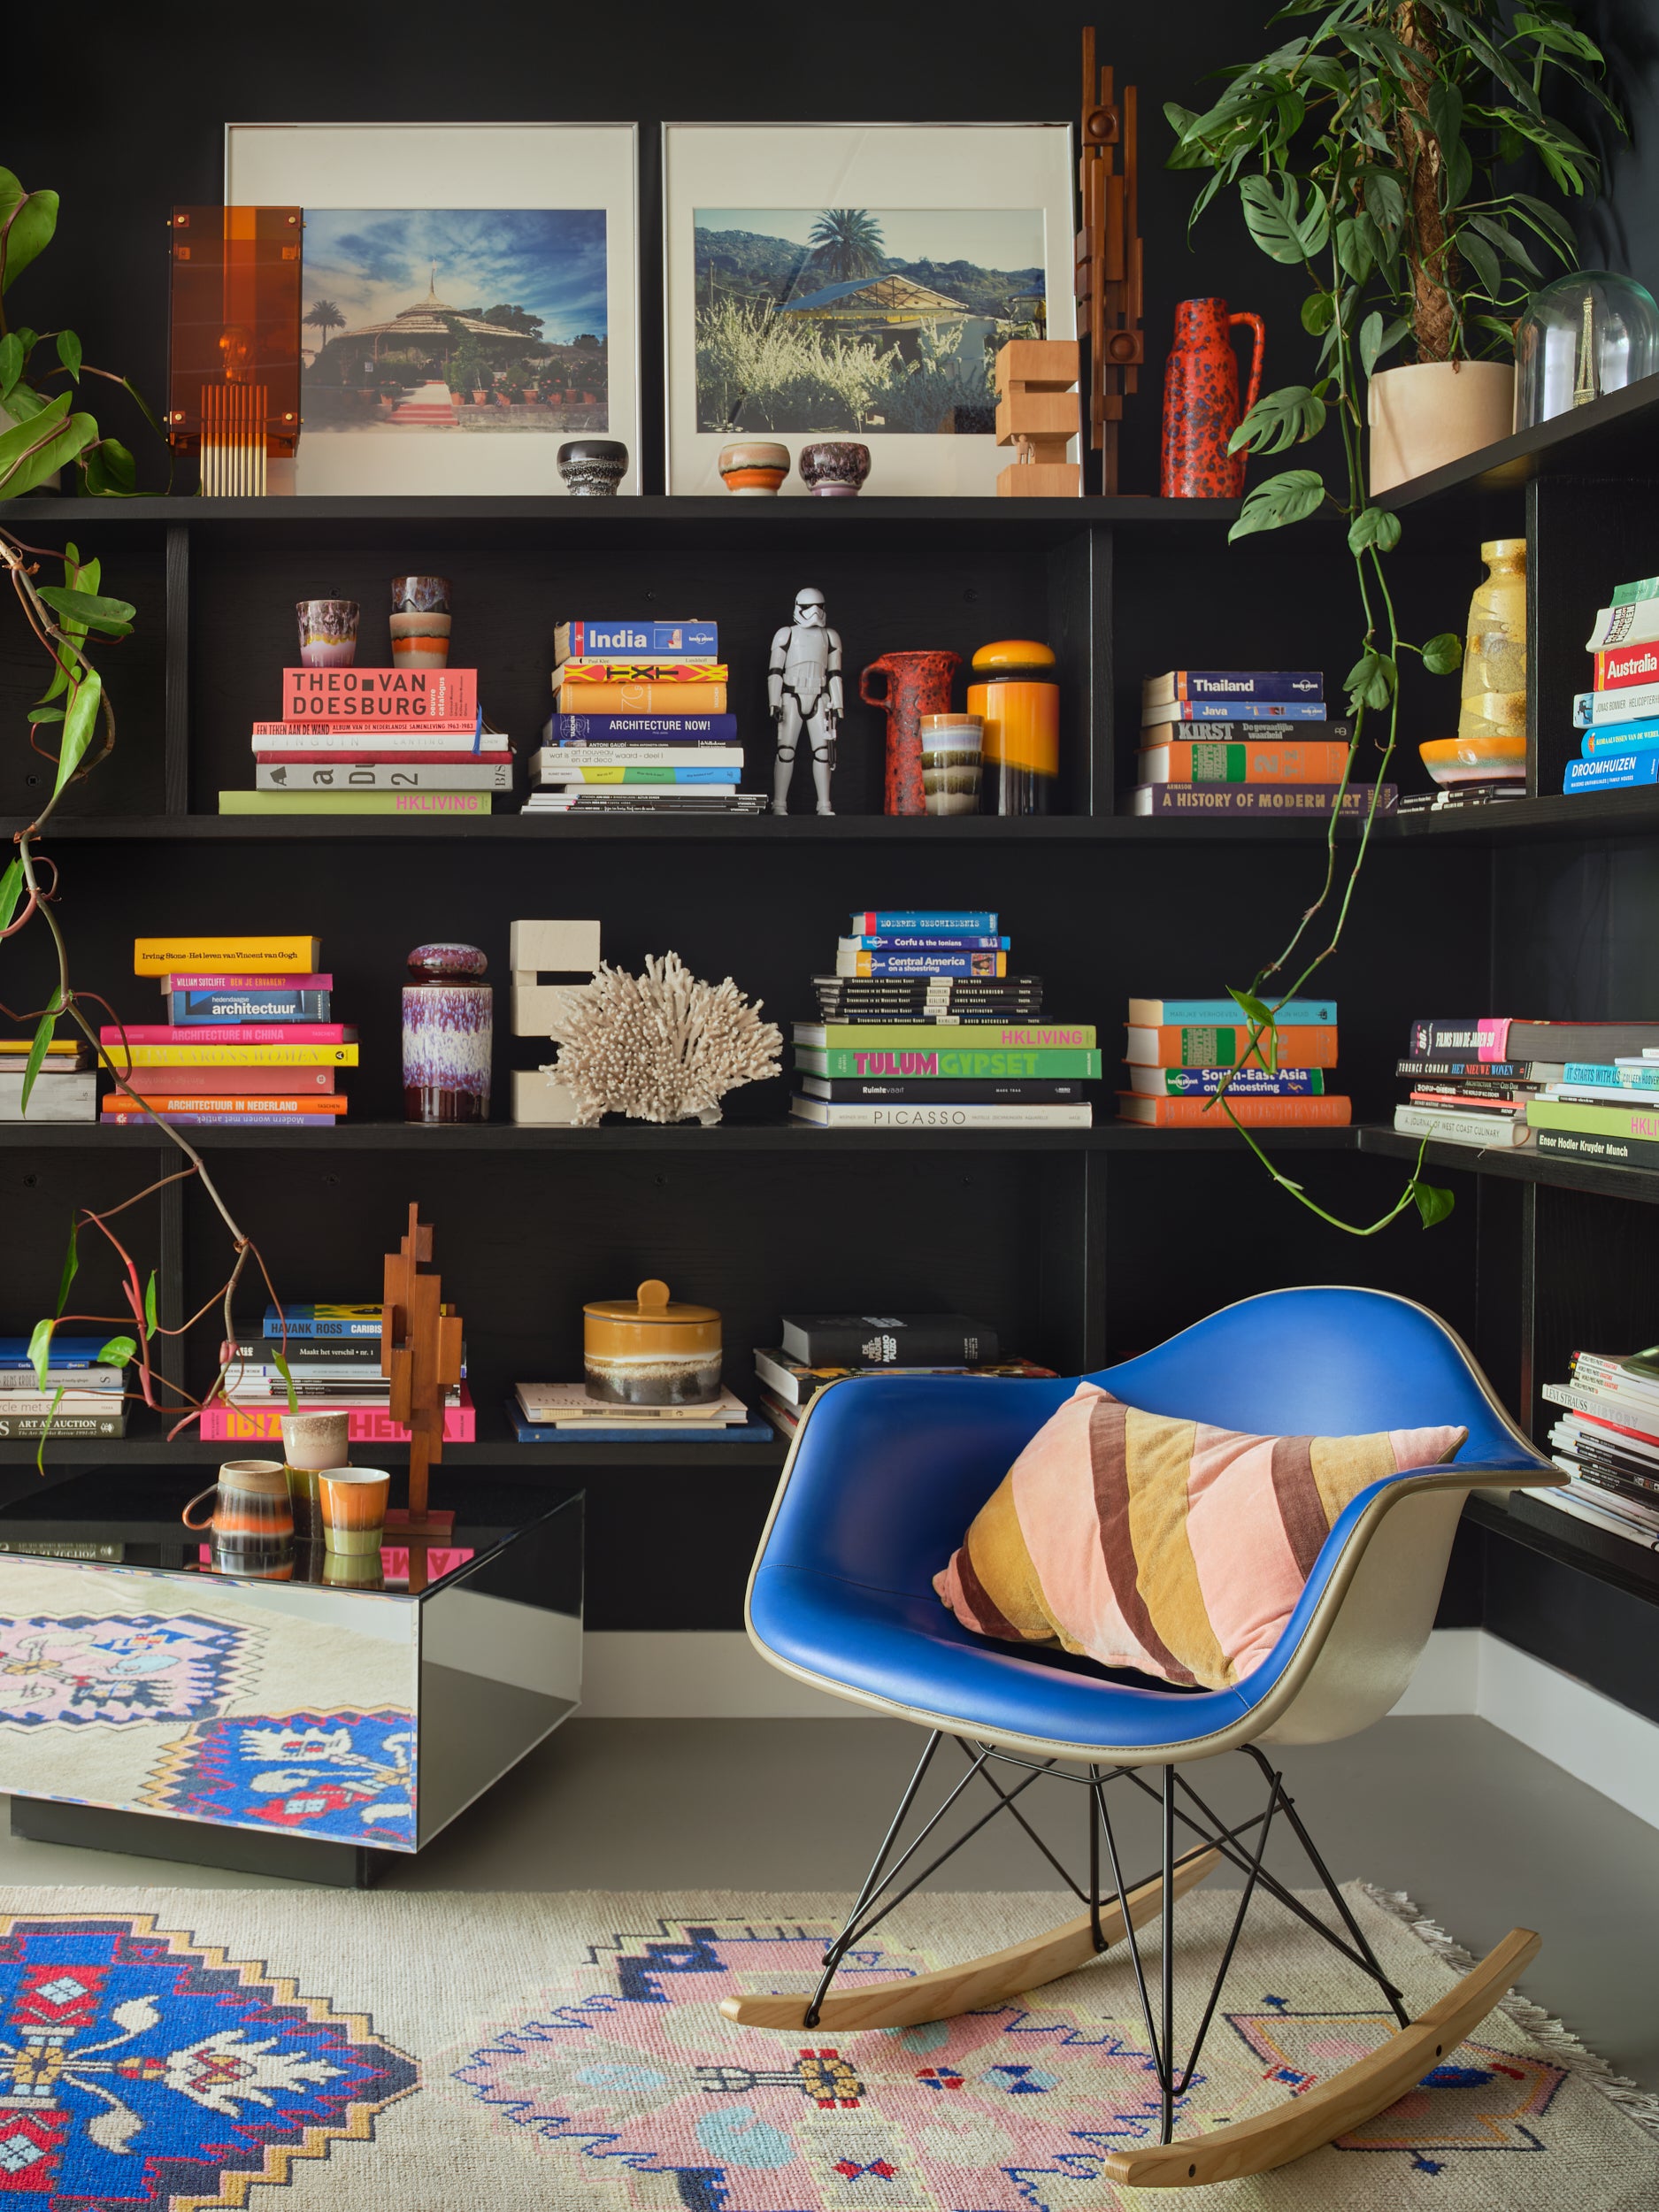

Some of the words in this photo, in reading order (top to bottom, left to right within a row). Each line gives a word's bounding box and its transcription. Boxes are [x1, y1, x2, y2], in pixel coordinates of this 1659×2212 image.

[1617, 604, 1636, 641] MORGEN
[589, 629, 648, 648] India
[606, 665, 679, 680] TXT
[1607, 653, 1657, 680] Australia
[292, 673, 358, 692] THEO
[379, 673, 426, 692] VAN
[1193, 679, 1255, 692] Thailand
[438, 676, 447, 717] catalogus
[293, 696, 426, 716] DOESBURG
[1202, 706, 1228, 716] Java
[257, 724, 267, 735] EEN
[269, 724, 287, 735] TEKEN
[288, 724, 301, 735] AAN
[303, 724, 310, 735] DE
[311, 724, 330, 735] WAND
[609, 720, 682, 730] ARCHITECTURE
[685, 720, 711, 730] NOW!
[1178, 723, 1233, 741] KIRST
[1595, 735, 1627, 746] KORAALVISSEN
[1254, 754, 1279, 773] 2
[1571, 757, 1637, 778] DROOMHUIZEN
[396, 795, 479, 810] HKLIVING
[1163, 794, 1172, 807] A
[1177, 793, 1232, 807] HISTORY
[1236, 793, 1254, 807] OF
[1258, 794, 1325, 808] MODERN
[1331, 794, 1361, 808] ART
[888, 957, 922, 966] Central
[925, 957, 965, 966] America
[177, 978, 198, 987] WILLIAM
[199, 978, 226, 987] SUTCLIFFE
[230, 978, 243, 987] BEN
[244, 978, 253, 987] JE
[256, 978, 286, 987] ERVAREN?
[211, 1002, 296, 1015] architectuur
[172, 1029, 240, 1041] ARCHITECTURE
[242, 1029, 253, 1041] IN
[255, 1028, 284, 1041] CHINA
[1001, 1030, 1083, 1045] HKLIVING
[1435, 1032, 1452, 1048] FILMS
[1452, 1032, 1463, 1048] VAN
[1463, 1032, 1471, 1048] DE
[1470, 1032, 1487, 1048] JAREN
[1486, 1032, 1495, 1048] 90
[177, 1049, 245, 1063] AARONS
[248, 1048, 321, 1062] WOMEN
[853, 1052, 939, 1075] TULUM
[940, 1052, 1039, 1075] GYPSET
[1398, 1063, 1423, 1073] TERENCE
[1425, 1064, 1448, 1073] CONRAN
[1451, 1064, 1465, 1074] HET
[1465, 1064, 1491, 1075] NIEUWE
[1491, 1064, 1514, 1076] WONEN
[1279, 1069, 1308, 1080] Asia
[1565, 1068, 1573, 1079] IT
[1574, 1069, 1594, 1082] STARTS
[1595, 1070, 1610, 1083] WITH
[1612, 1071, 1621, 1084] US
[1623, 1073, 1641, 1084] COLLEEN
[1228, 1082, 1280, 1094] shoestring
[168, 1100, 233, 1110] ARCHITECTUUR
[235, 1100, 245, 1110] IN
[247, 1101, 298, 1111] NEDERLAND
[273, 1116, 304, 1125] Modern
[873, 1110, 966, 1125] PICASSO
[1410, 1118, 1432, 1127] JOURNAL
[1441, 1121, 1455, 1130] WEST
[1455, 1124, 1473, 1133] COAST
[1474, 1126, 1501, 1138] CULINARY
[1539, 1134, 1557, 1148] Ensor
[1557, 1137, 1578, 1151] Hodler
[1579, 1140, 1605, 1154] Kruyder
[1606, 1143, 1628, 1157] Munch
[271, 1323, 312, 1334] HAVANK
[316, 1323, 342, 1334] ROSS
[862, 1344, 869, 1355] DE
[19, 1375, 36, 1387] KROES
[1546, 1386, 1559, 1401] LEVI
[1560, 1393, 1588, 1411] STRAUSS
[20, 1402, 45, 1411] met
[53, 1419, 96, 1428] AUCTION
